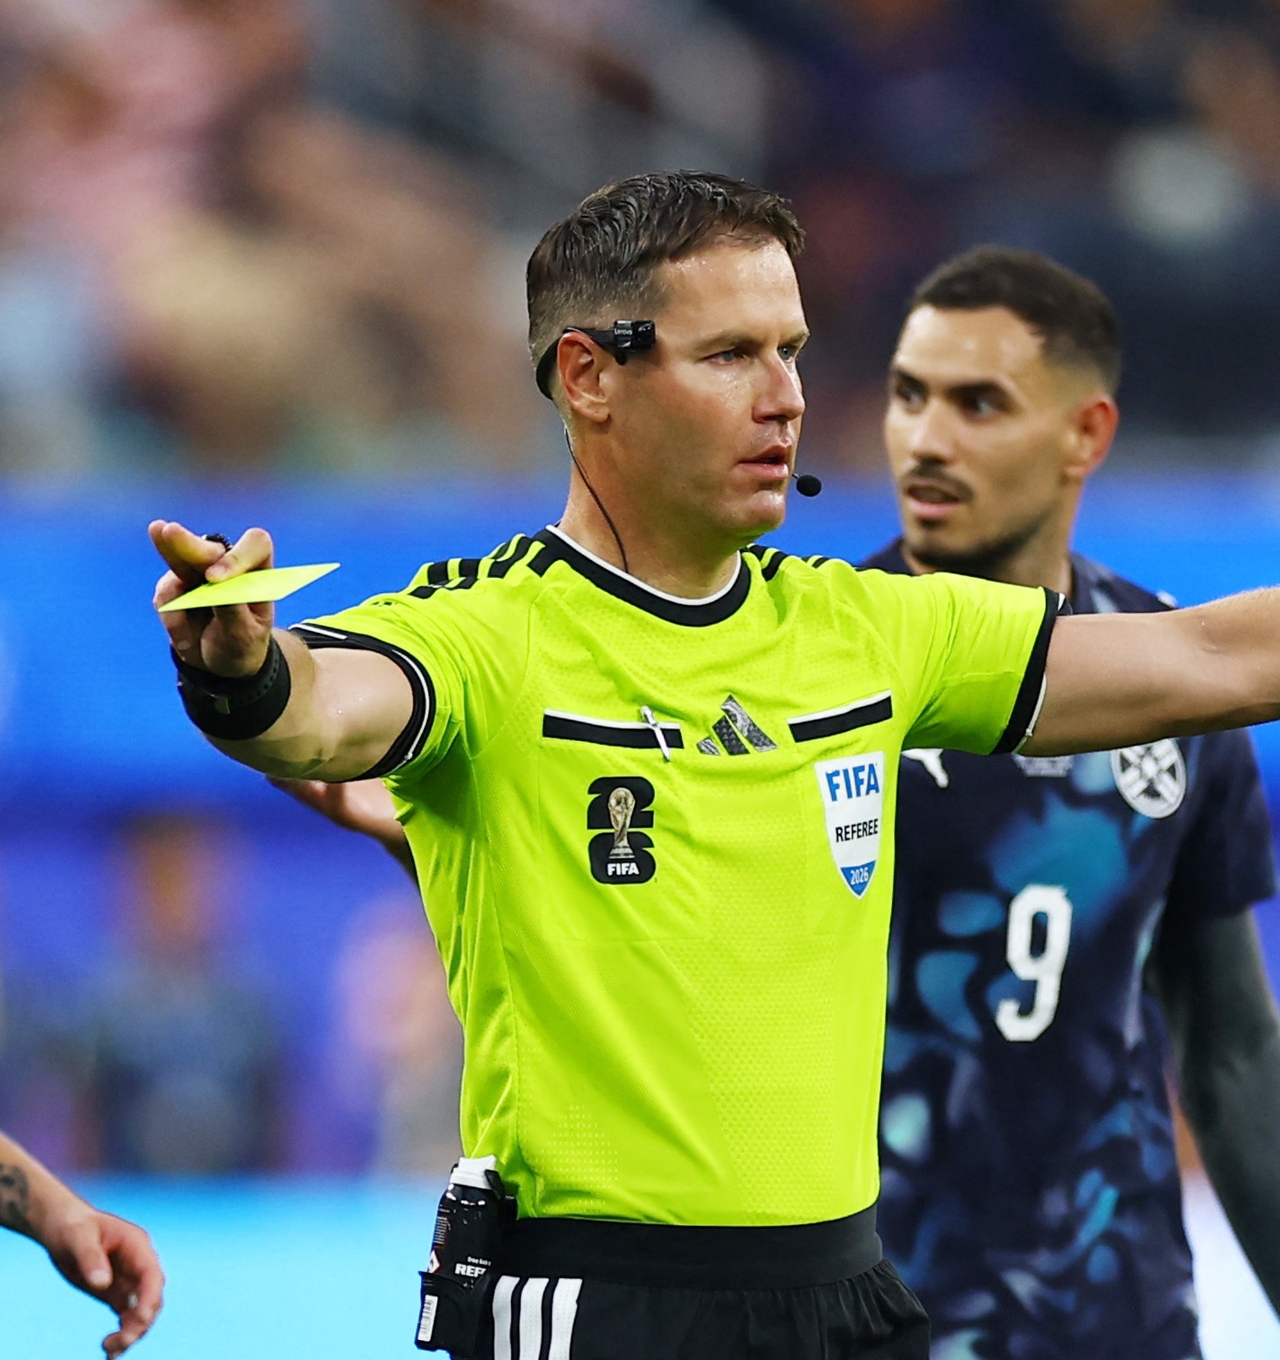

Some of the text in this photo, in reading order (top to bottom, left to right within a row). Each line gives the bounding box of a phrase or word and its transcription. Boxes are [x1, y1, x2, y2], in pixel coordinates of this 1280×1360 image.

[825, 763, 880, 802] FIFA
[835, 818, 879, 843] REFEREE
[606, 862, 640, 876] FIFA
[850, 866, 869, 886] 2026
[995, 884, 1073, 1042] 9
